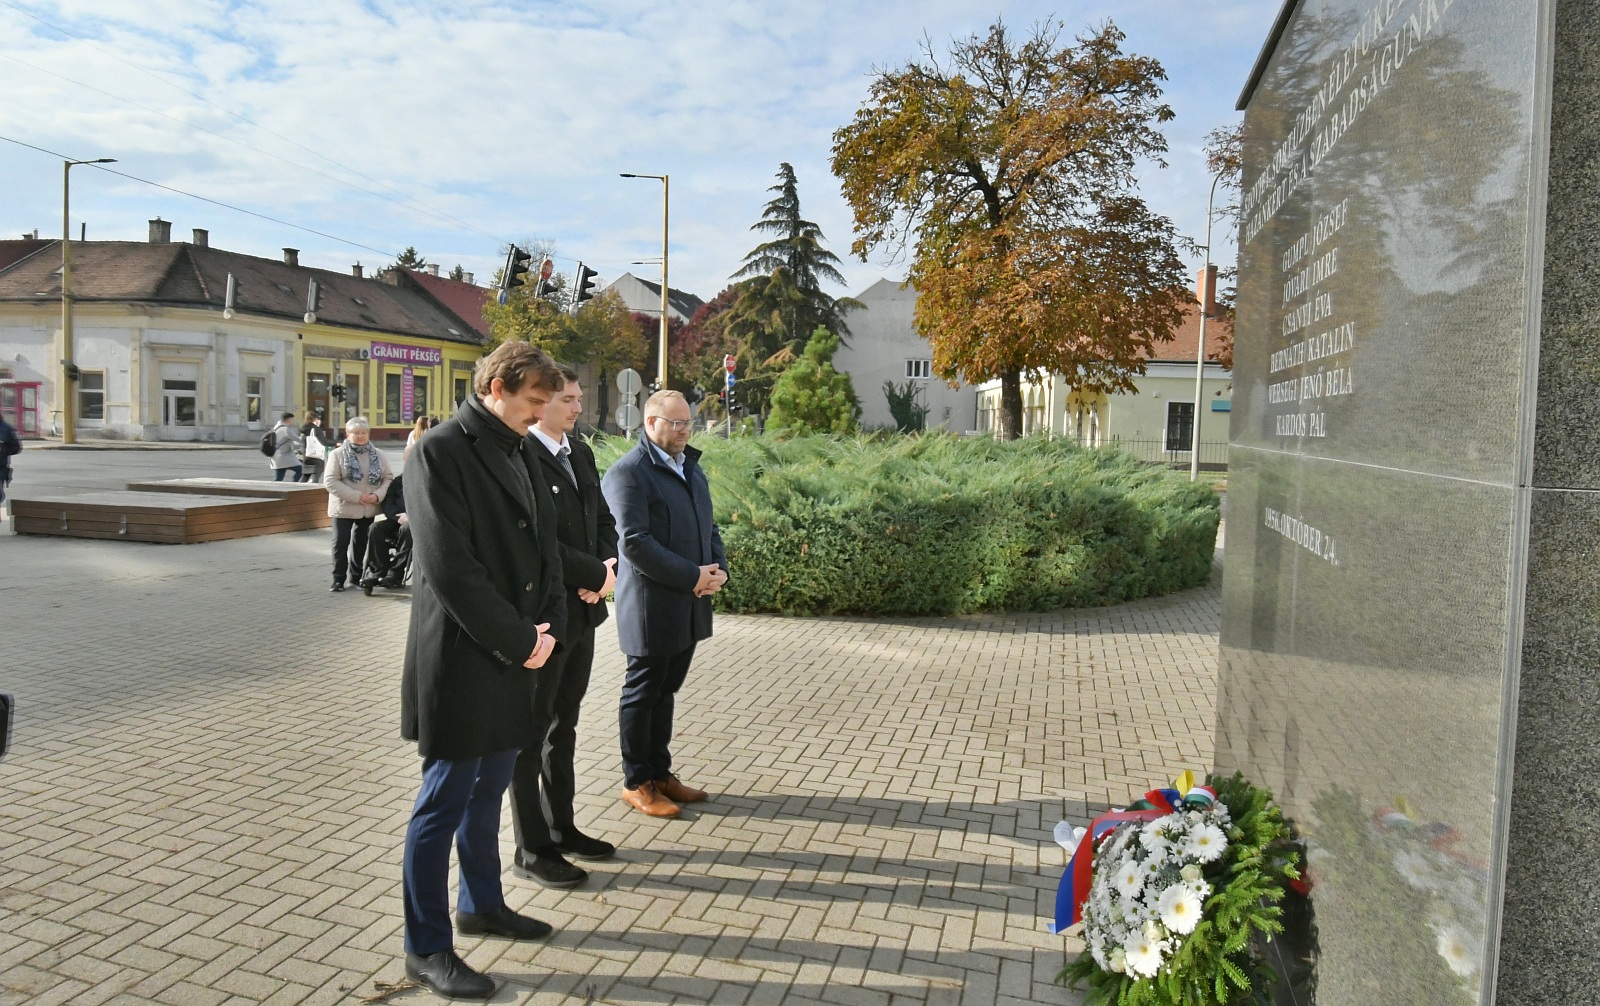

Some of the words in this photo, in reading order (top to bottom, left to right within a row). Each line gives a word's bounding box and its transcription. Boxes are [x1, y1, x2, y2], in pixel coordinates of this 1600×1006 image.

[1328, 0, 1404, 105] ÉLETÜKE
[1310, 0, 1454, 170] SZABADSÁGUNK
[1312, 197, 1348, 255] JÓZSEF
[1282, 266, 1309, 309] JÓVÁRI
[1312, 247, 1338, 286] IMRE
[1314, 289, 1331, 322] ÉVA
[373, 345, 408, 359] GRÁNIT
[410, 348, 440, 362] PÉKSÉG
[1270, 340, 1304, 373] BERNÁTH
[1308, 321, 1355, 361] KATALIN
[1268, 379, 1297, 404] VERSEGI
[1299, 366, 1323, 405] JENŐ
[1326, 361, 1353, 396] BÉLA
[1276, 414, 1306, 436] KARDOS
[1309, 405, 1326, 437] PÁL
